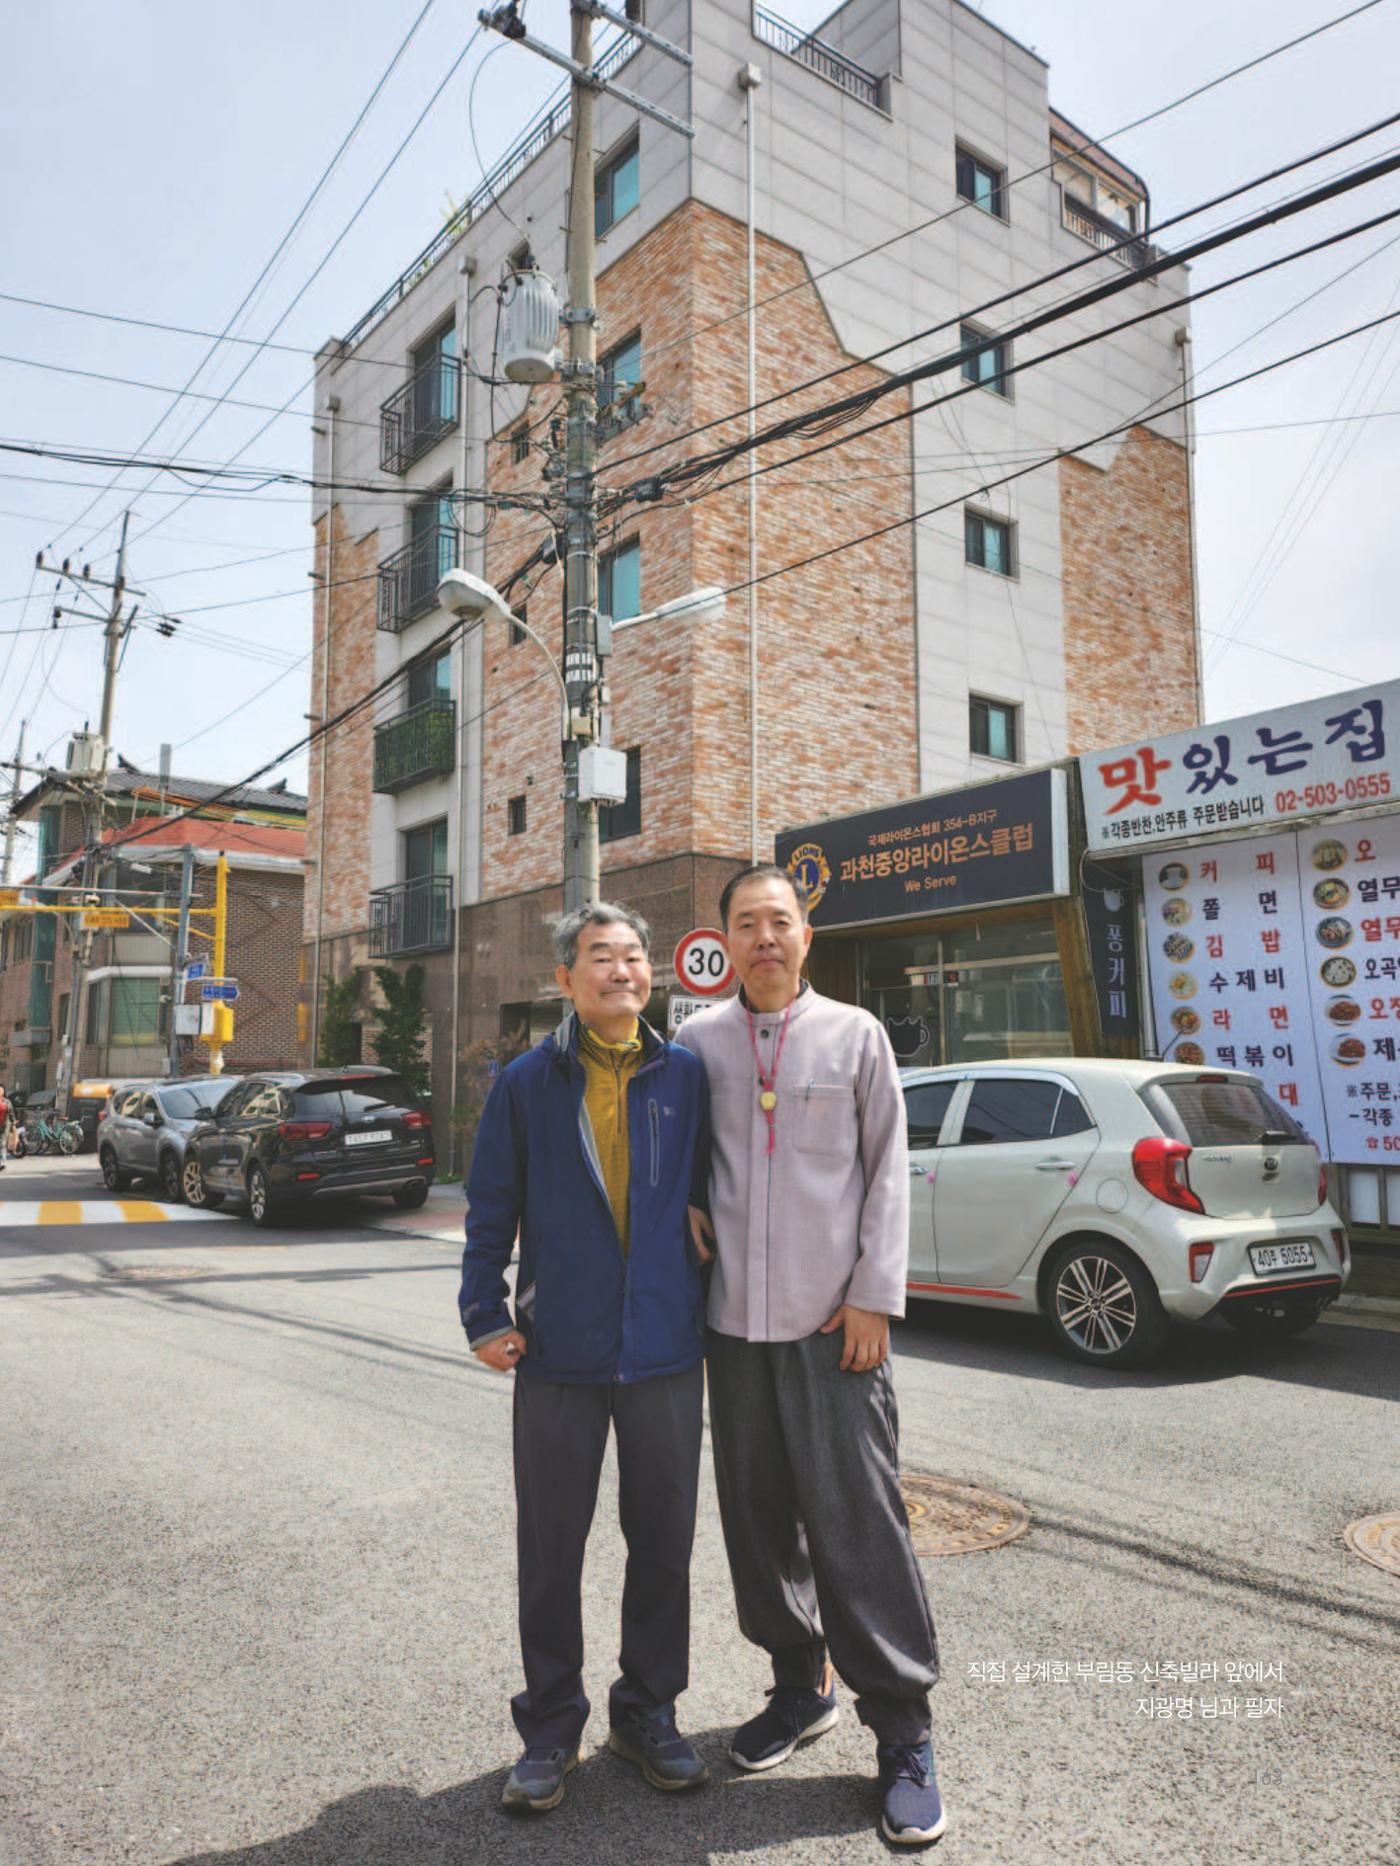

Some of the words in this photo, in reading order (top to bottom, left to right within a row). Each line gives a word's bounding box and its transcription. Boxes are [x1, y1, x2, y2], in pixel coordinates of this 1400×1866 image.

[1275, 772, 1391, 813] 02-503-0555
[1193, 794, 1264, 826] 주문받습니다
[840, 822, 1034, 883] 과천중앙라이온스클럽
[904, 879, 921, 893] We
[924, 875, 957, 890] Serve
[688, 947, 724, 977] 30
[1364, 957, 1400, 981] 오곡
[1280, 1245, 1308, 1265] 5055
